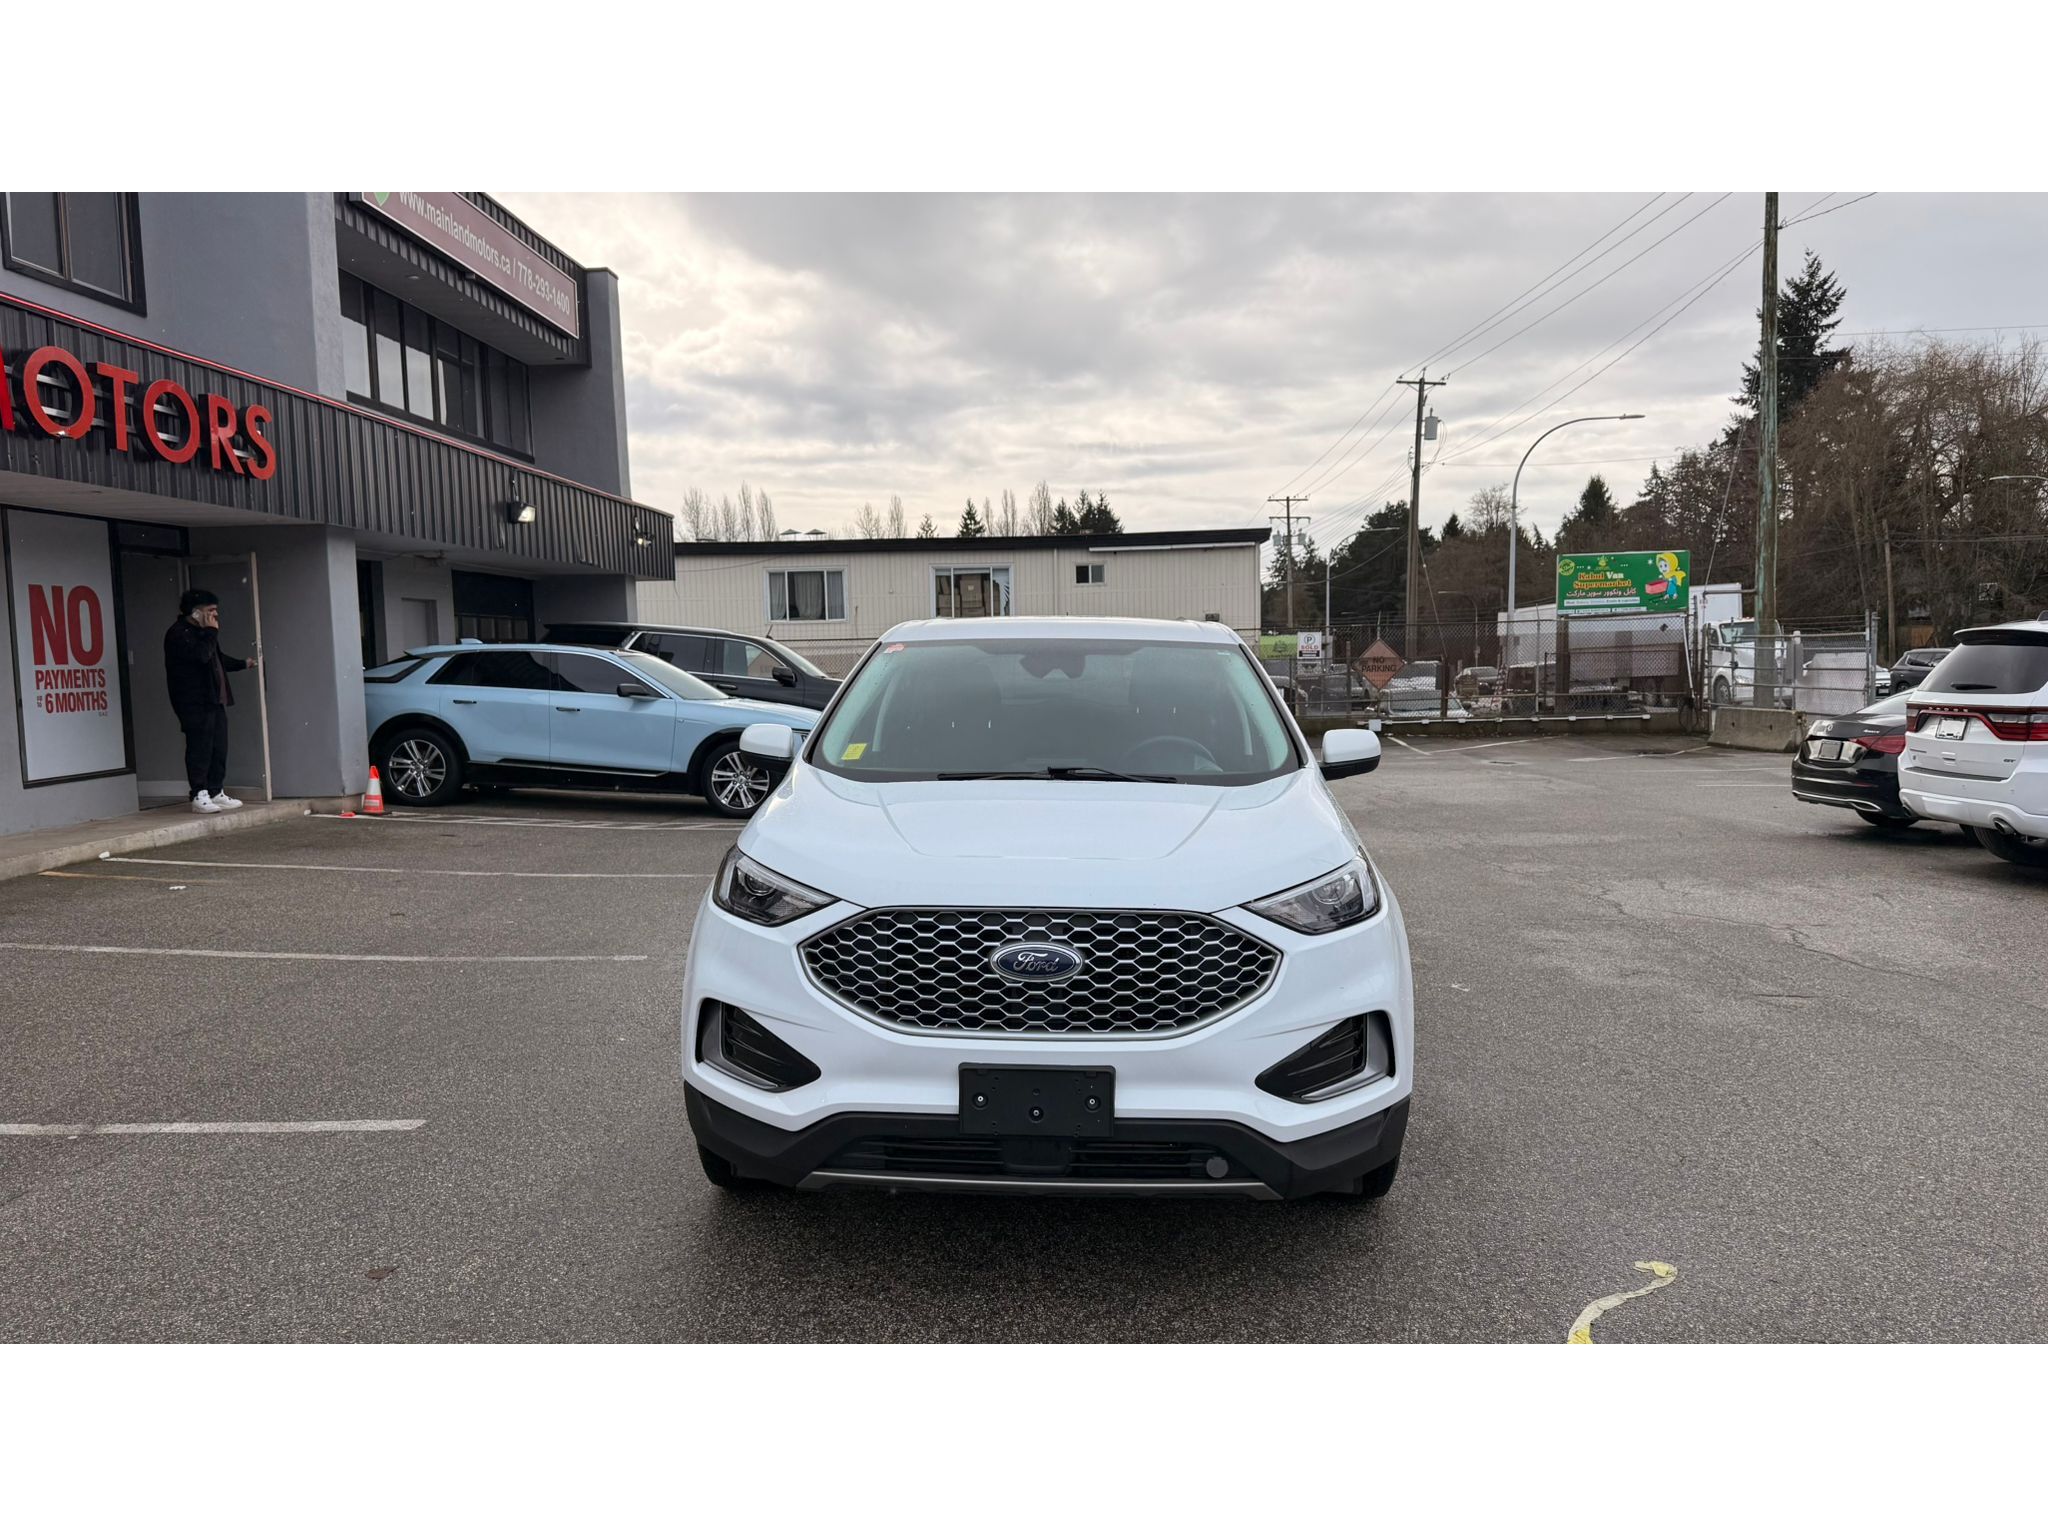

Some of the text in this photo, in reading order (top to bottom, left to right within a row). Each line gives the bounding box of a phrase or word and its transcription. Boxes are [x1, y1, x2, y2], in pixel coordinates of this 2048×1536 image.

[399, 192, 511, 276] www.mainlandmotors.ca
[517, 261, 570, 315] 778-293-1400
[0, 345, 276, 480] OTORS
[1574, 580, 1632, 589] Supermarket
[1606, 571, 1624, 579] Van
[28, 584, 104, 666] NO
[35, 668, 106, 690] PAYMENTS
[1361, 665, 1397, 673] PARKING
[45, 693, 54, 714] 6
[55, 691, 108, 713] MONTHS
[1013, 951, 1060, 972] Ford
